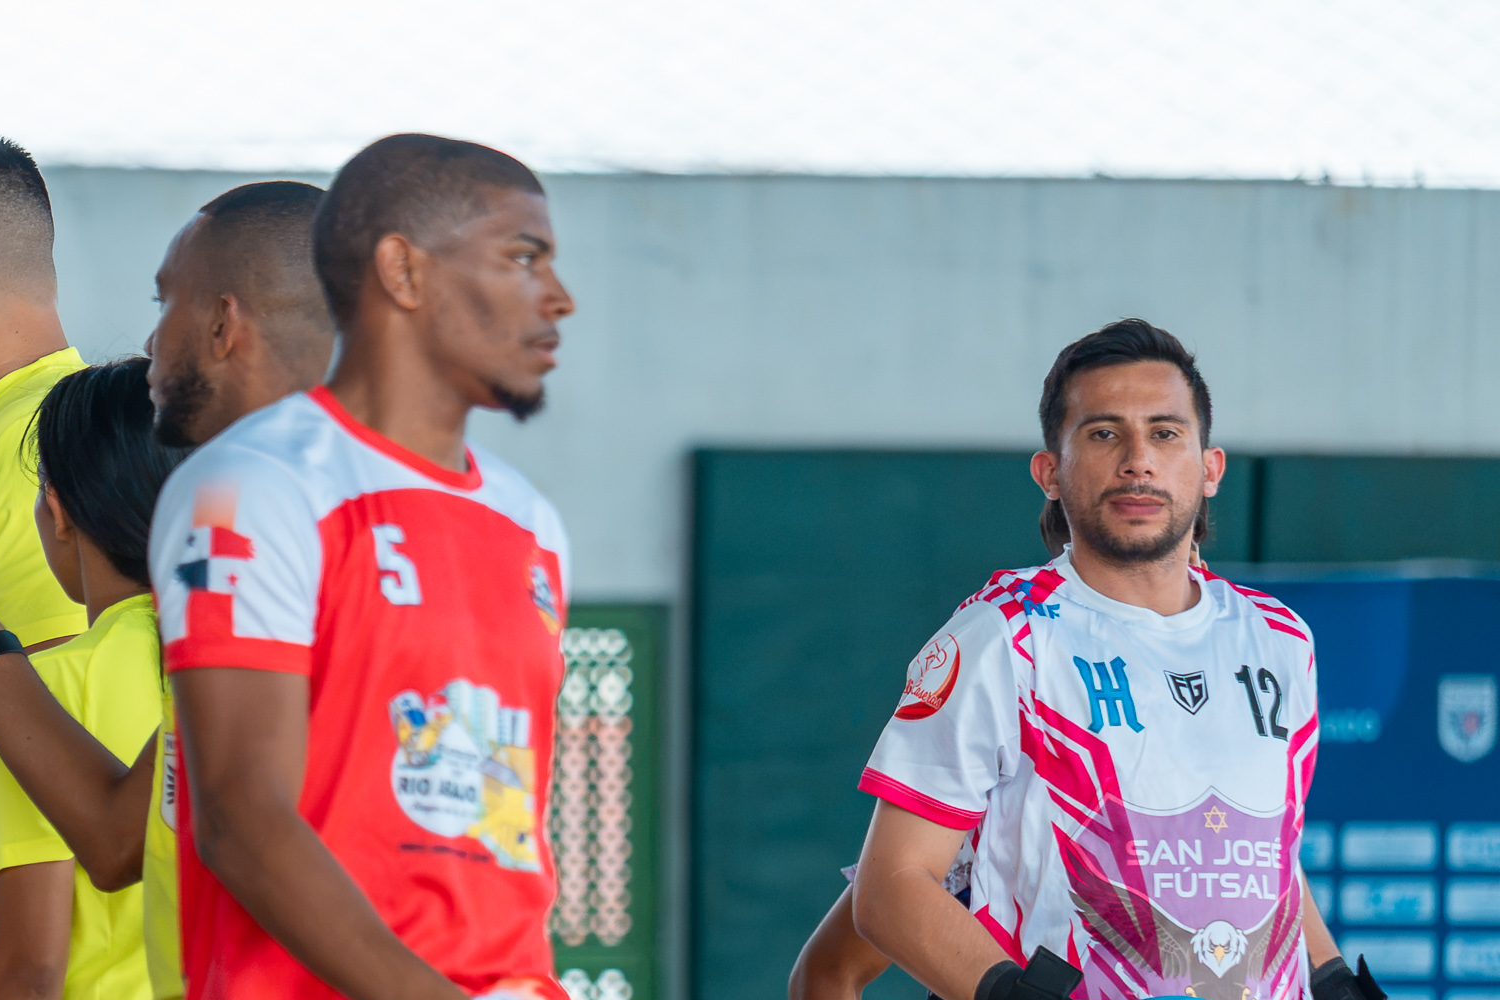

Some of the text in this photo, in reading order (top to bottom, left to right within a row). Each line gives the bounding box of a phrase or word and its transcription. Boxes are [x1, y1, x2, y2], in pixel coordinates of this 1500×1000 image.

[372, 525, 423, 605] 5
[1234, 664, 1288, 742] 12
[1126, 836, 1285, 870] SAN JOSÉ
[1153, 866, 1277, 901] FÚTSAL
